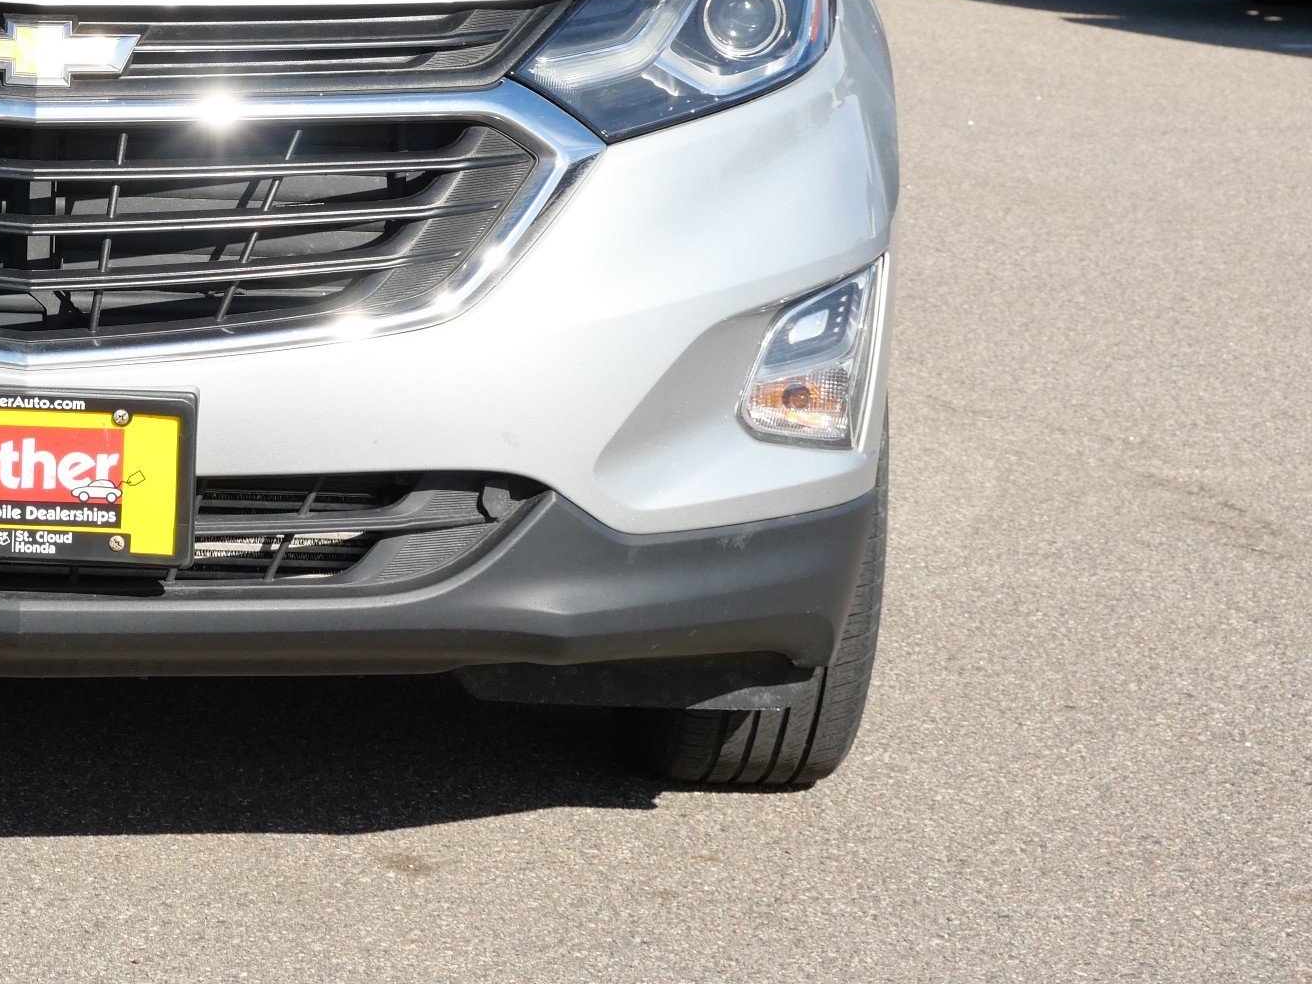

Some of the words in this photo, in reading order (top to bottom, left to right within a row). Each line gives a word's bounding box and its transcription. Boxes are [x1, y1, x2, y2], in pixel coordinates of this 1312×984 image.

[25, 505, 116, 524] Dealerships
[15, 530, 33, 542] St.
[35, 531, 73, 545] Cloud
[14, 541, 57, 554] Honda
